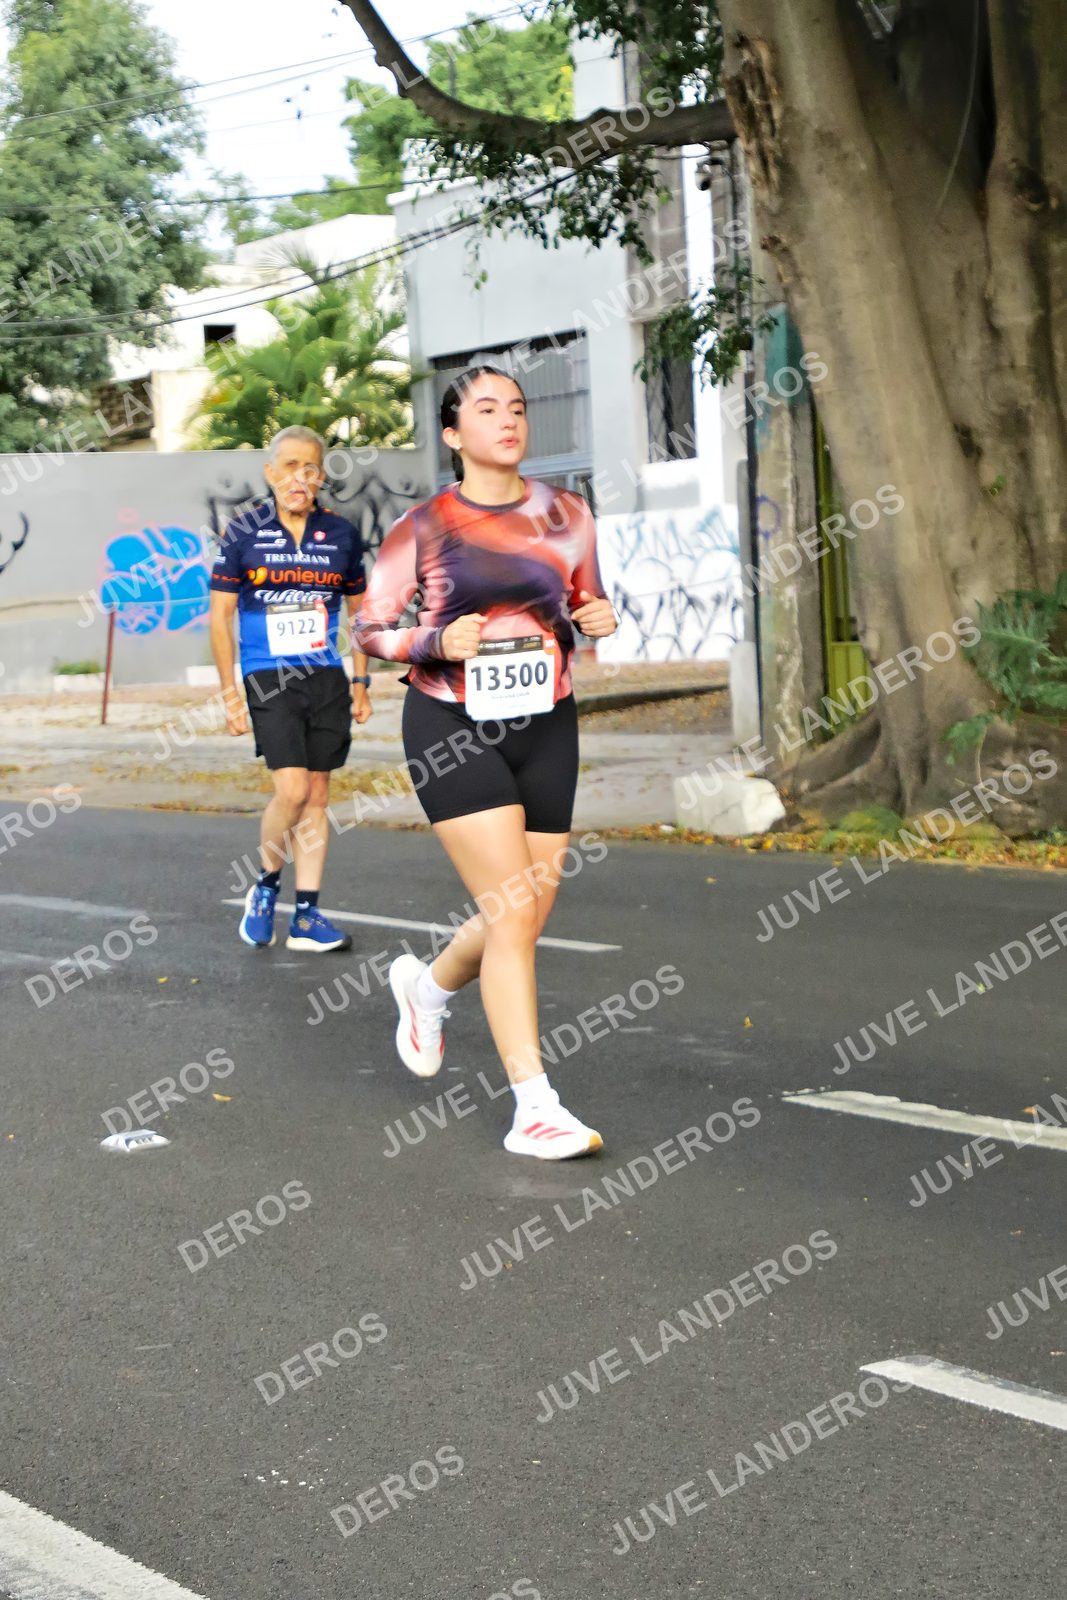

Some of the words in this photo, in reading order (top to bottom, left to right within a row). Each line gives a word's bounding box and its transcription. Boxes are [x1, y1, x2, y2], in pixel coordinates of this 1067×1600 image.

[264, 553, 330, 565] TREVIGIANI
[270, 566, 343, 586] unieuro
[277, 618, 316, 636] 9122
[470, 661, 548, 691] 13500
